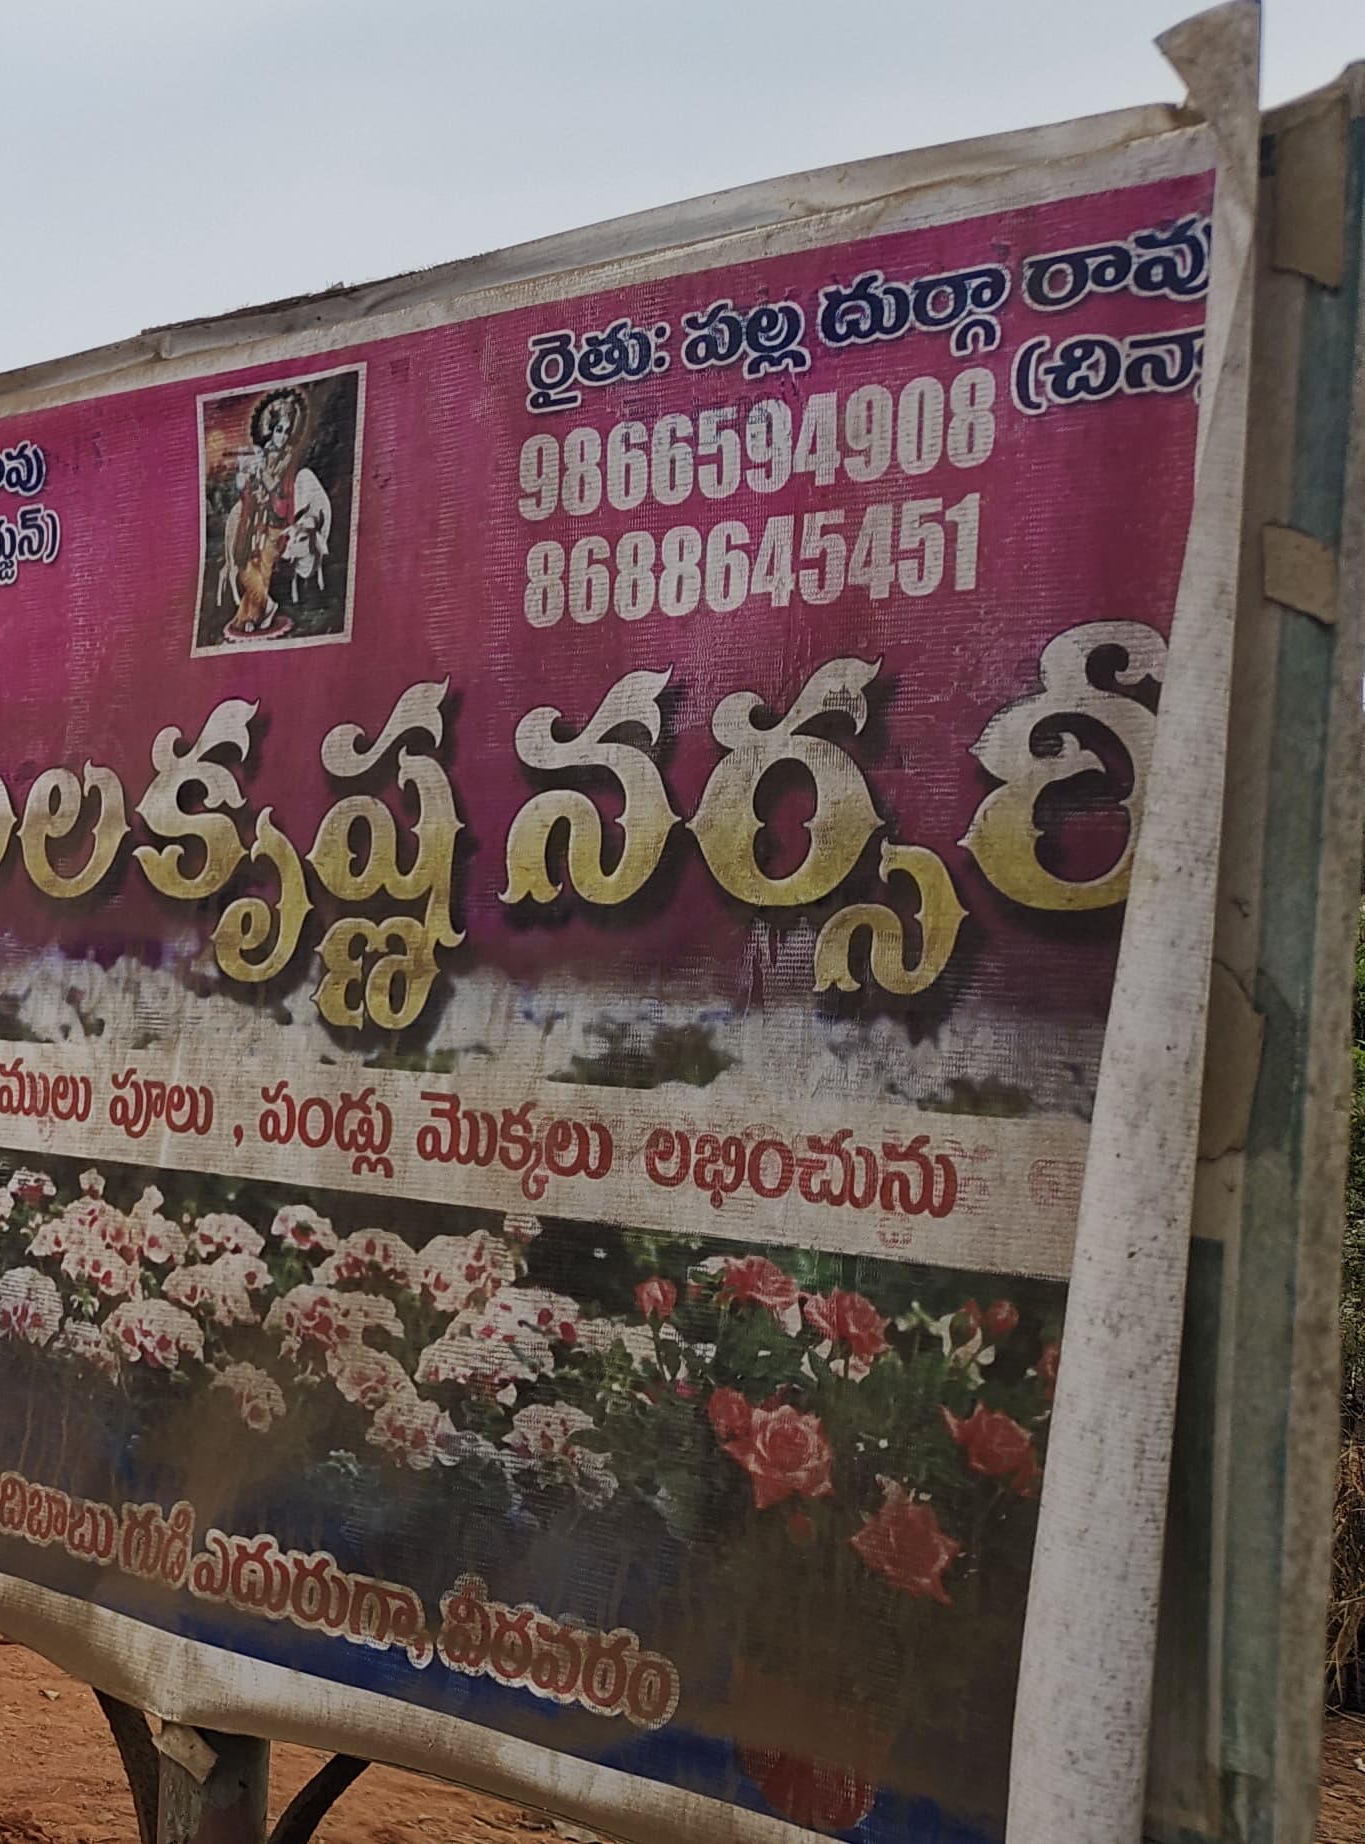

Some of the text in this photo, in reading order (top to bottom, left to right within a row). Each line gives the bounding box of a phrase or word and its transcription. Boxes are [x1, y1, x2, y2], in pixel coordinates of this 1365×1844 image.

[526, 318, 671, 410] రైతు:
[681, 299, 810, 378] పల్ల
[818, 269, 1011, 356] దుర్గా
[519, 368, 997, 522] 9866594908
[524, 493, 982, 628] 8688645451
[498, 620, 1169, 995] నర్సరీ
[109, 1067, 215, 1138] పూలు
[259, 1080, 394, 1178] పండ్లు
[416, 1091, 612, 1201] మొక్కలు
[645, 1127, 958, 1218] లభించును
